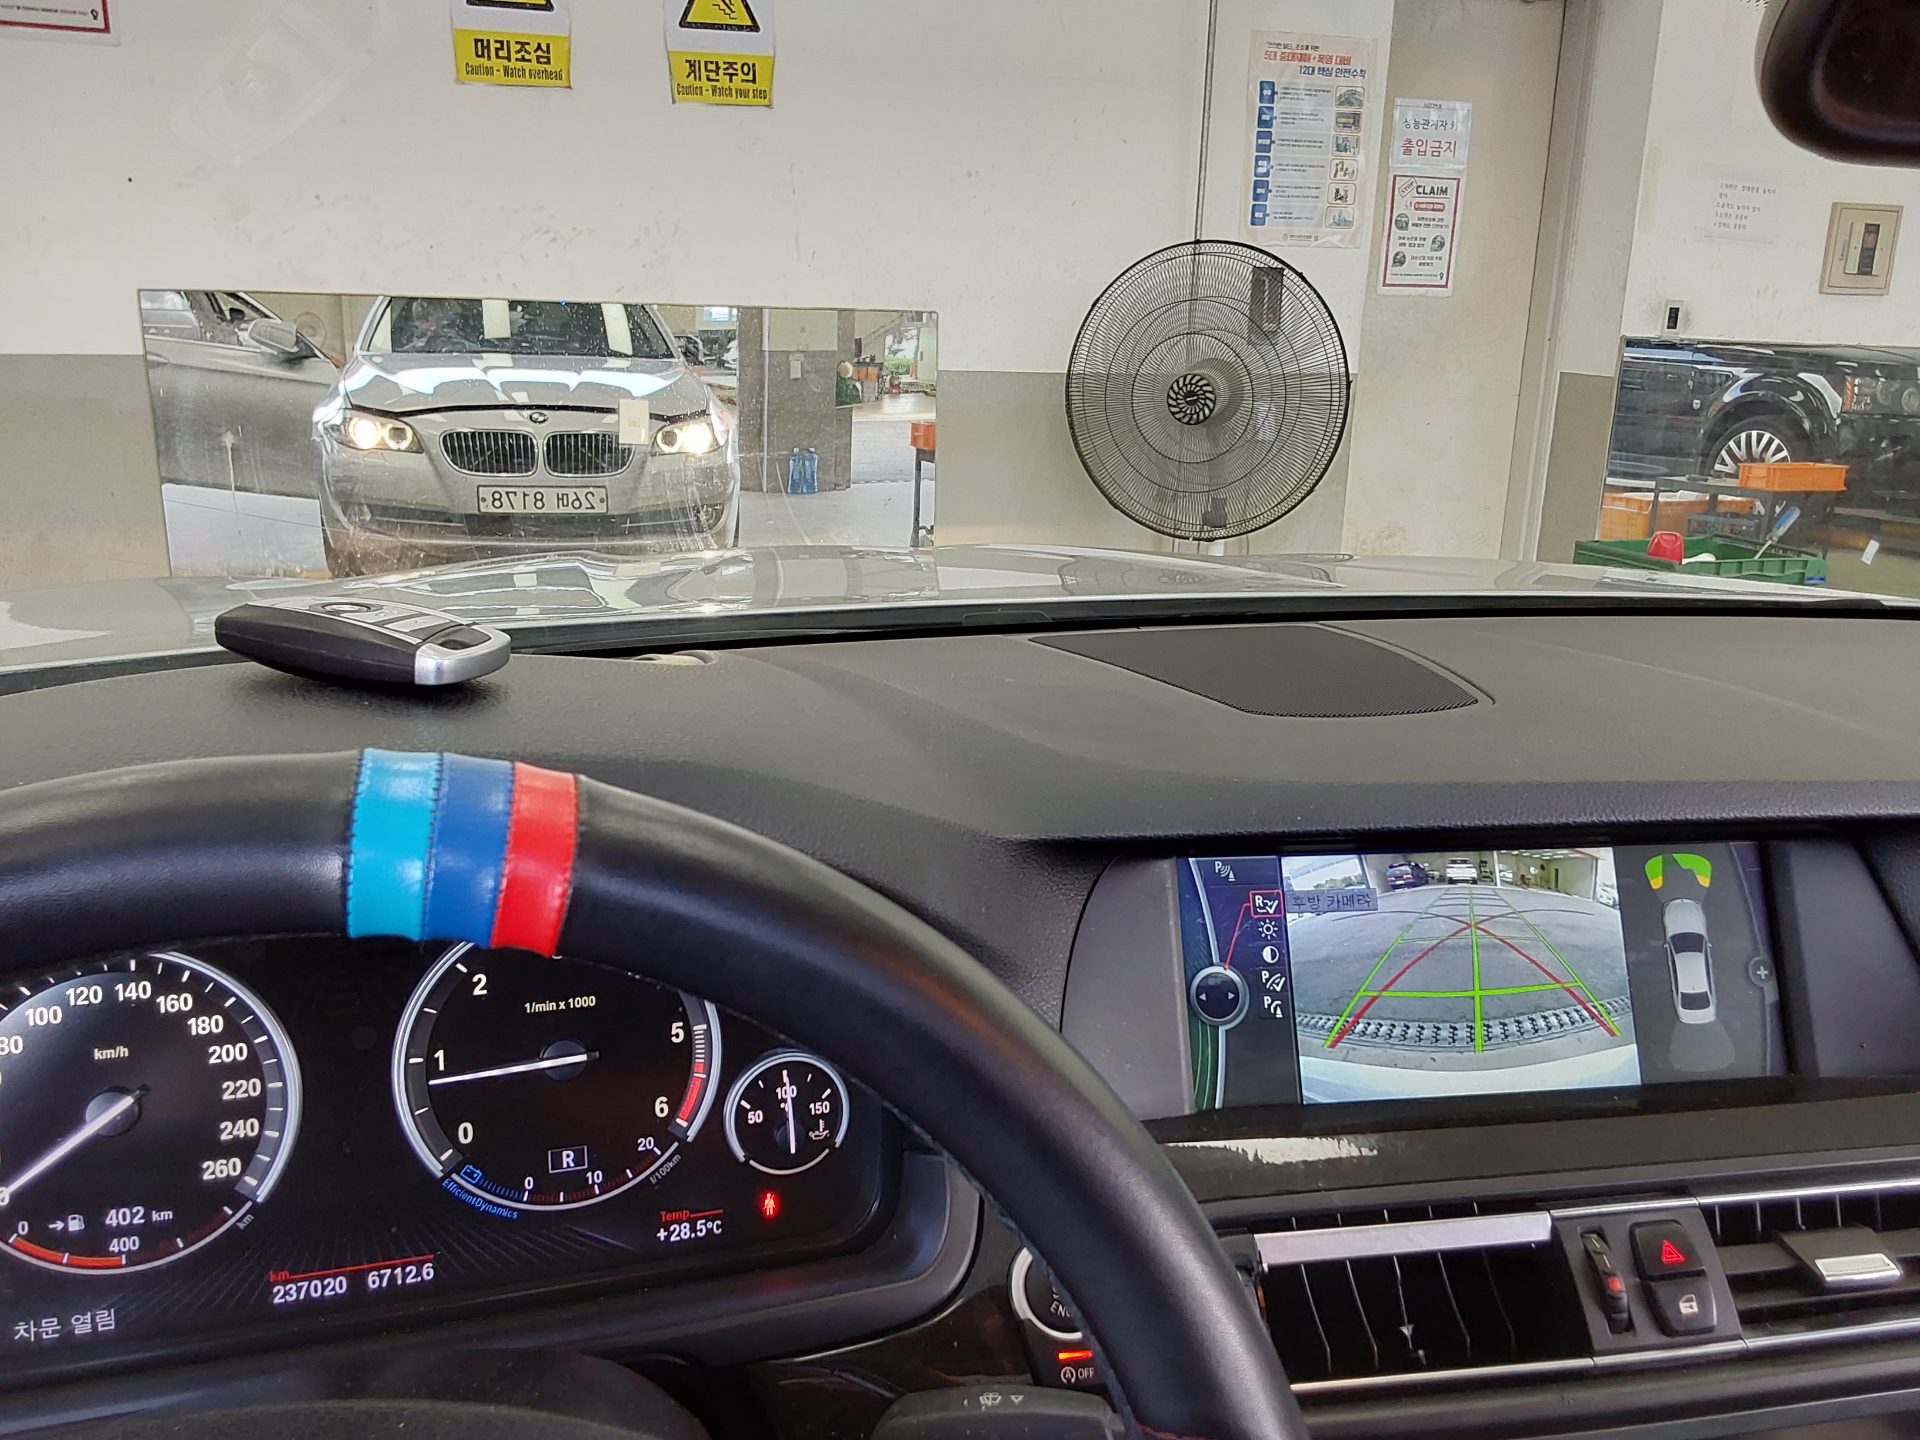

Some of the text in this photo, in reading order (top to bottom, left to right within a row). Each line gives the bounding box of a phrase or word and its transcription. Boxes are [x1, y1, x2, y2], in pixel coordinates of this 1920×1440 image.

[473, 37, 551, 65] 머리조심
[465, 62, 494, 77] Caution
[502, 64, 526, 79] Watch
[528, 67, 563, 81] overhead
[685, 58, 757, 84] 계단주의
[1299, 65, 1315, 76] 12대
[676, 83, 703, 96] Caution
[710, 84, 733, 97] Watch
[735, 86, 750, 99] your
[752, 87, 768, 100] step
[1400, 137, 1457, 158] 출입금지
[1416, 185, 1449, 196] CLAIM
[1291, 894, 1372, 910] 후방 카메라
[115, 981, 152, 1002] 140
[472, 973, 488, 995] 2
[66, 986, 103, 1006] 120
[156, 993, 193, 1014] 160
[524, 995, 596, 1014] 1/min x 1000
[25, 1006, 62, 1027] 100
[187, 1015, 224, 1036] 180
[671, 1022, 684, 1043] 5
[94, 1045, 129, 1060] km/h
[208, 1042, 248, 1064] 200
[433, 1050, 446, 1071] 1
[222, 1078, 262, 1100] 220
[775, 1085, 798, 1100] 100
[655, 1096, 669, 1118] 6
[747, 1110, 763, 1124] 50
[809, 1101, 830, 1115] 150
[219, 1118, 259, 1140] 240
[458, 1121, 474, 1143] 0
[637, 1137, 655, 1151] 20
[202, 1157, 241, 1180] 260
[562, 1150, 575, 1168] R
[524, 1176, 534, 1190] 0
[586, 1170, 603, 1184] 10
[441, 1178, 518, 1220] EfficientDynamics
[105, 1205, 173, 1227] 402 km
[236, 1213, 255, 1230] km
[660, 1209, 690, 1222] Temp
[18, 1220, 29, 1235] 0
[109, 1235, 140, 1253] 400
[272, 1262, 435, 1304] 237020 6712.6
[13, 1307, 116, 1342] 차문 열림
[1077, 1367, 1095, 1380] OFF
